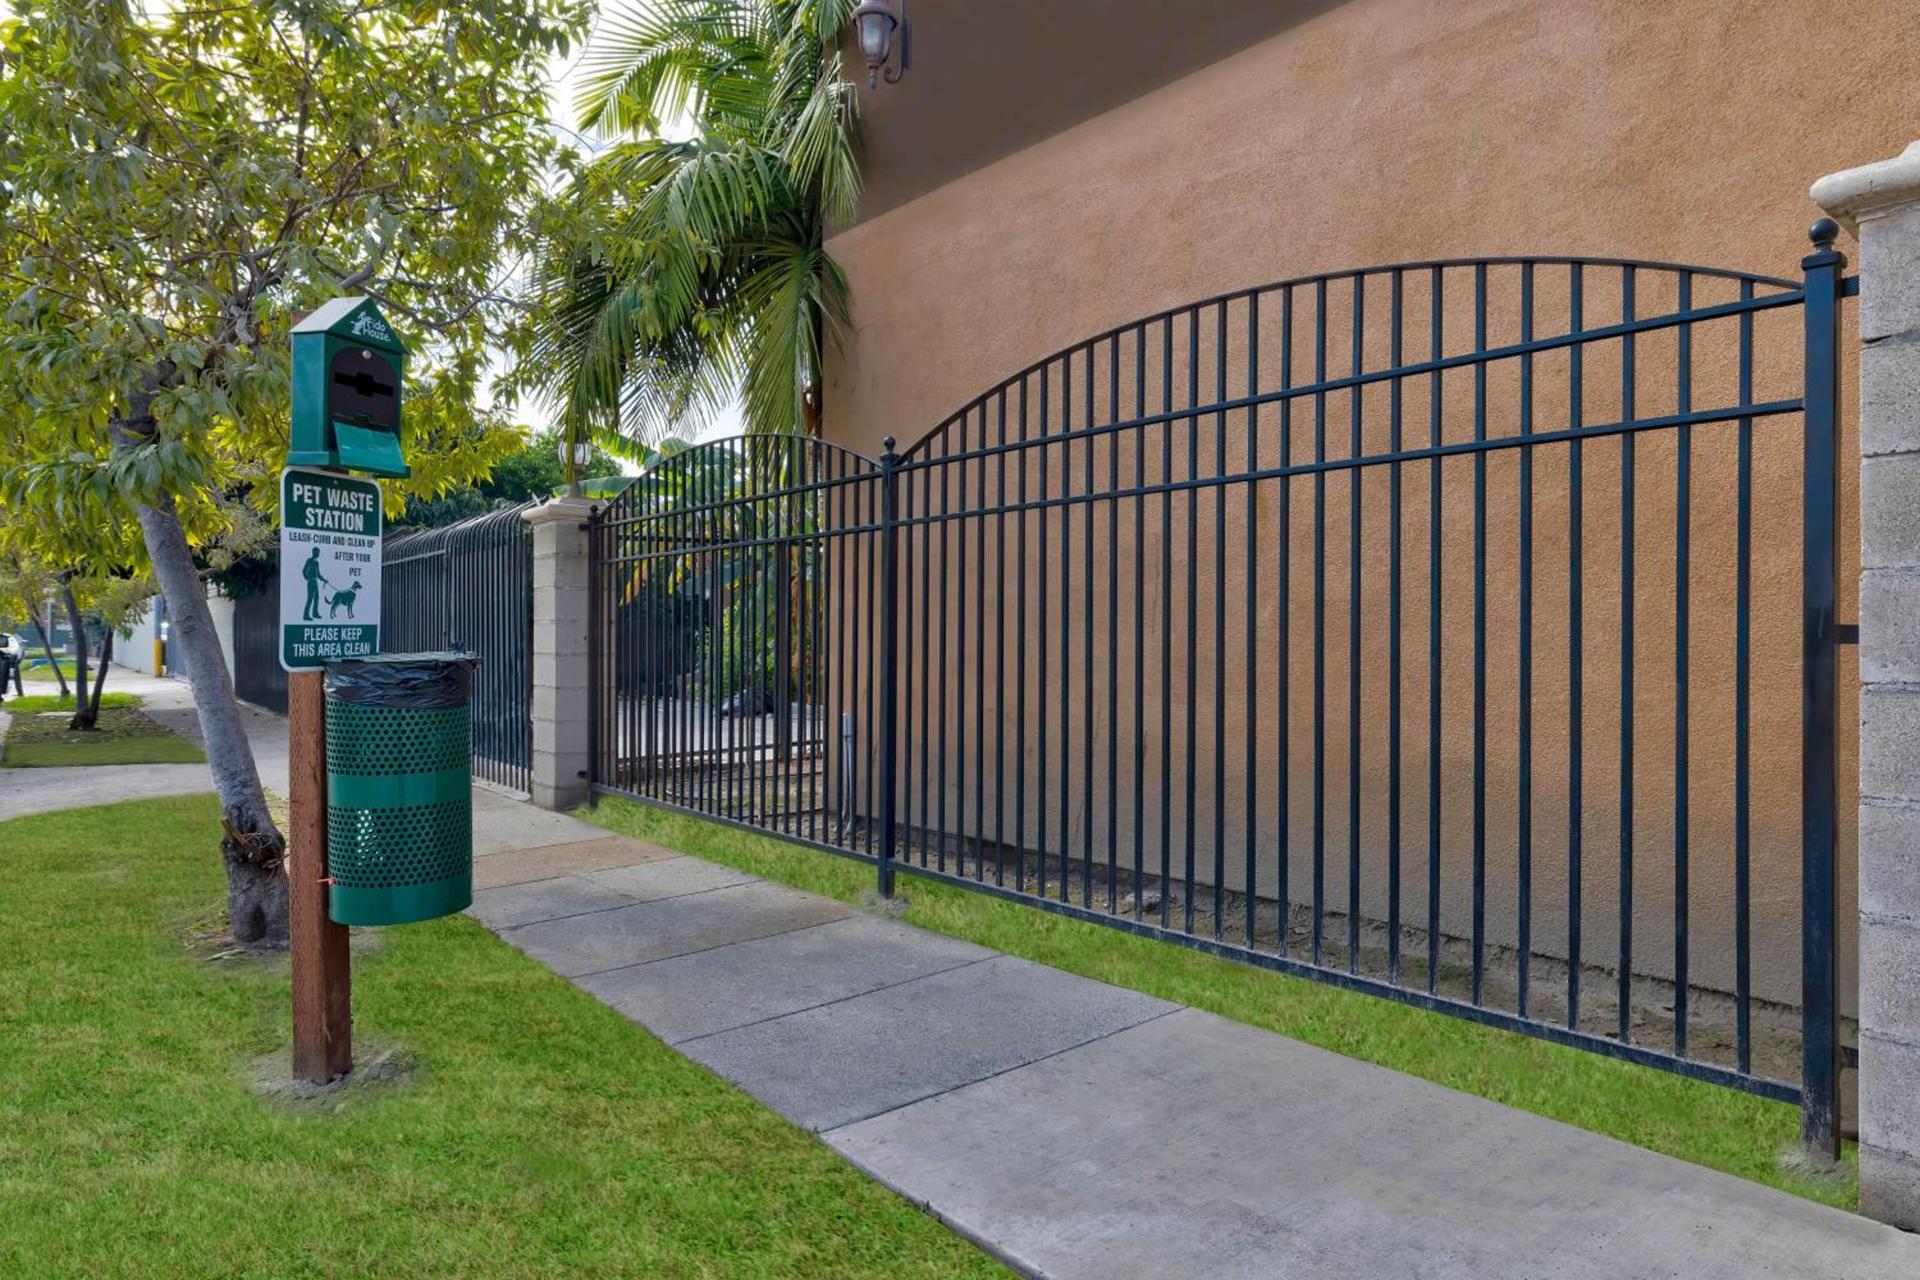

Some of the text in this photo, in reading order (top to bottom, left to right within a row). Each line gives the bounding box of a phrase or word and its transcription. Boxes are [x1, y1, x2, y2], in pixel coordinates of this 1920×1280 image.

[292, 483, 374, 512] PET WASTE
[305, 507, 364, 532] STATION
[332, 535, 346, 546] AND
[347, 537, 366, 548] CLEAN
[367, 539, 376, 548] UP
[334, 551, 371, 562] AFTER YOUR
[348, 567, 362, 576] PET
[304, 627, 363, 641] PLEASE KEEP
[293, 642, 371, 657] THIS AREA CLEAN
